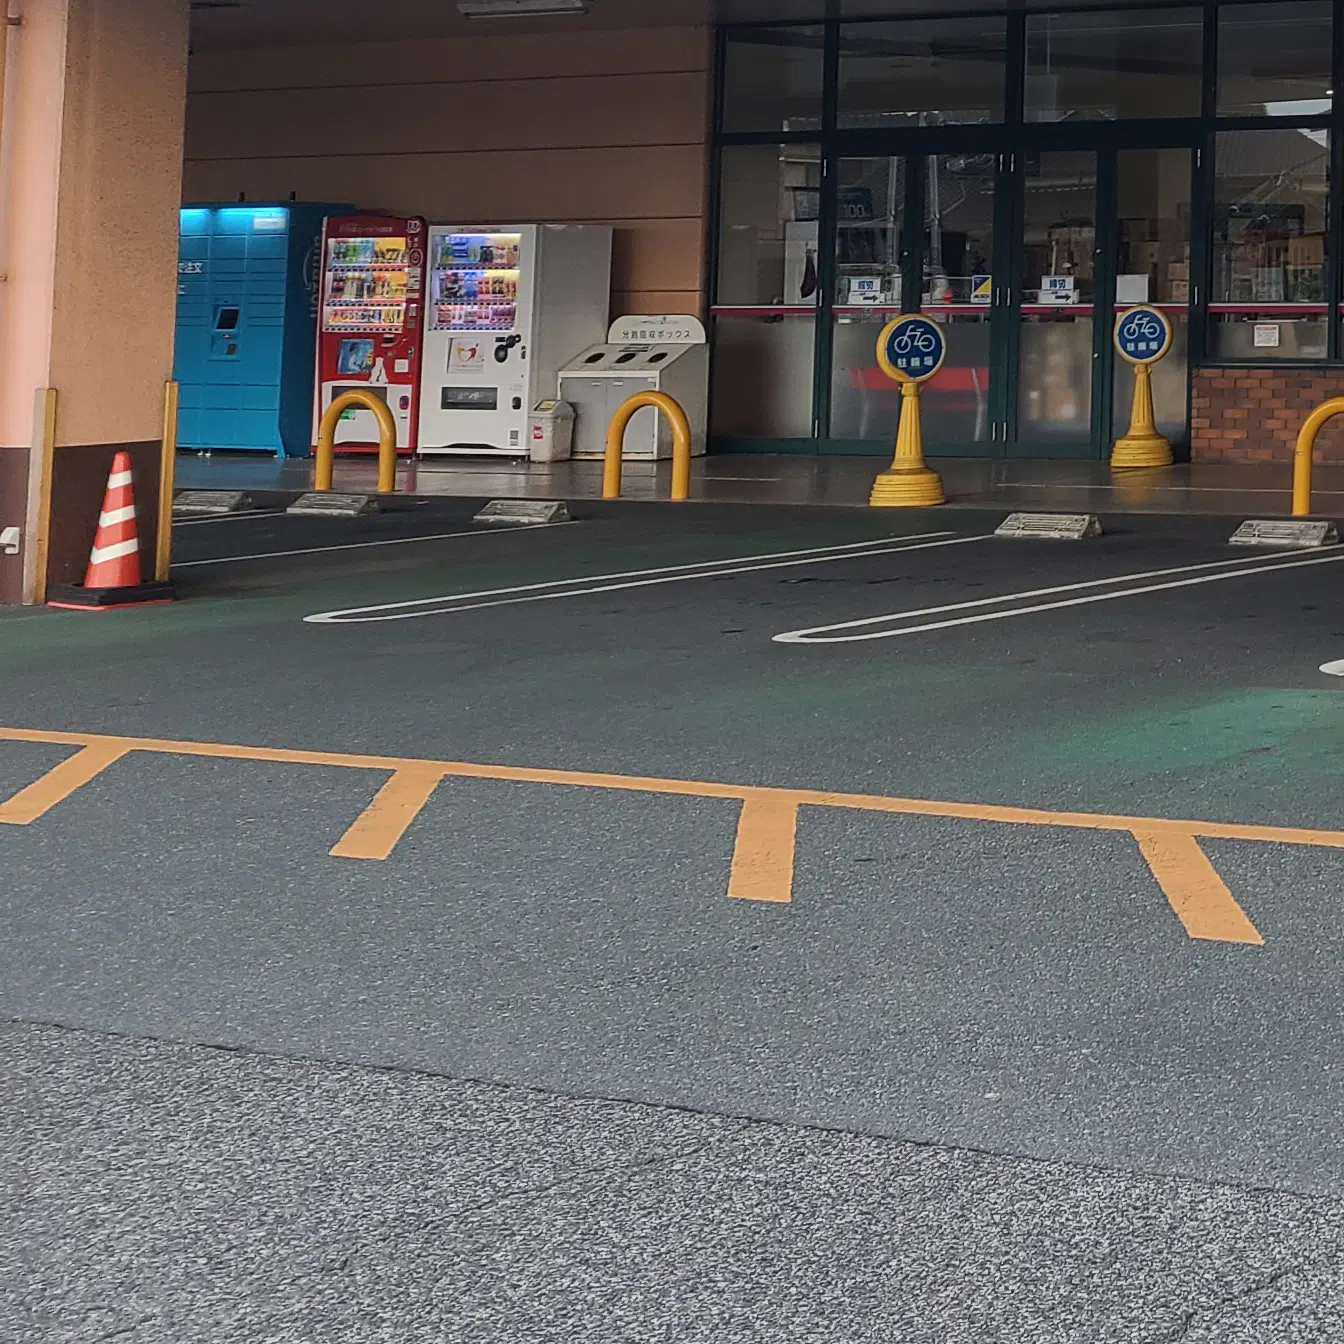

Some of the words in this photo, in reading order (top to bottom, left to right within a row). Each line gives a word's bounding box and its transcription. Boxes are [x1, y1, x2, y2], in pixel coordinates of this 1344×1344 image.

[1126, 341, 1158, 352] 駐輪場
[896, 357, 934, 369] 駐輪場
